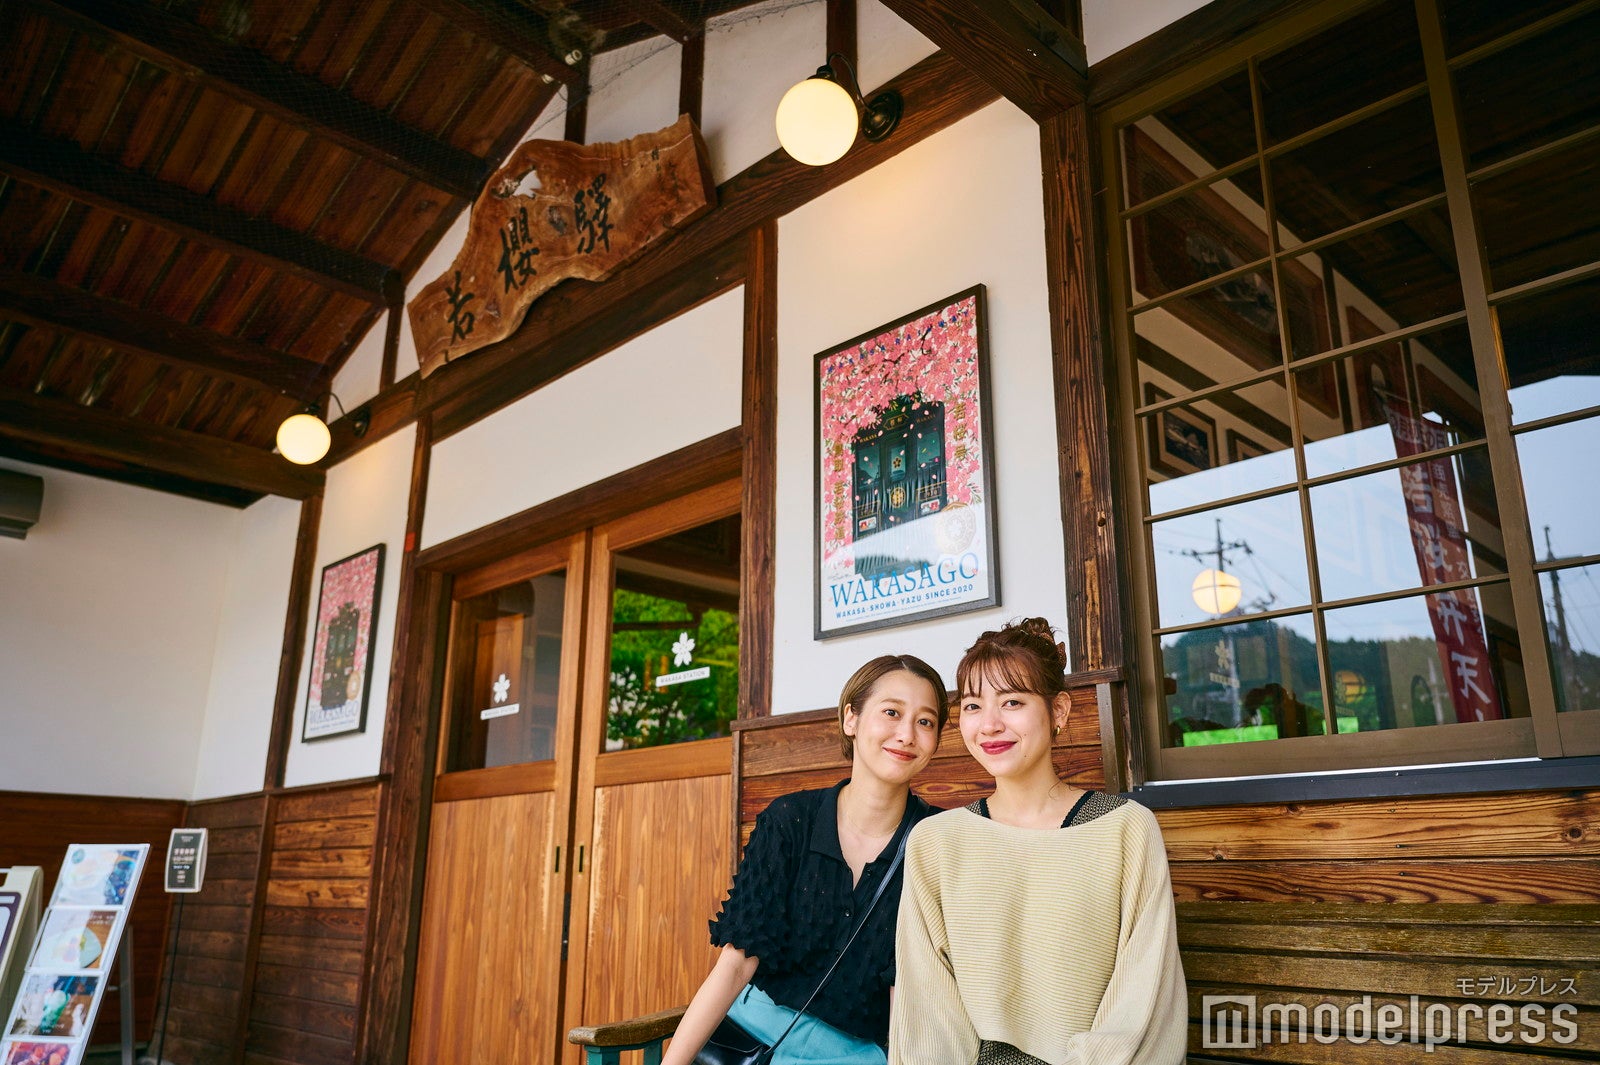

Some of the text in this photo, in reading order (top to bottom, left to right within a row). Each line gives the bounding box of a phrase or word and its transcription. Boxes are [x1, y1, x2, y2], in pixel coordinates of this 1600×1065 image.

[830, 552, 979, 608] WAKASAGO
[836, 606, 867, 619] WAKASA
[869, 600, 897, 612] SHOWA
[900, 595, 922, 606] YAZU
[925, 587, 951, 600] SINCE
[952, 583, 974, 595] 2020
[683, 670, 706, 680] STATION
